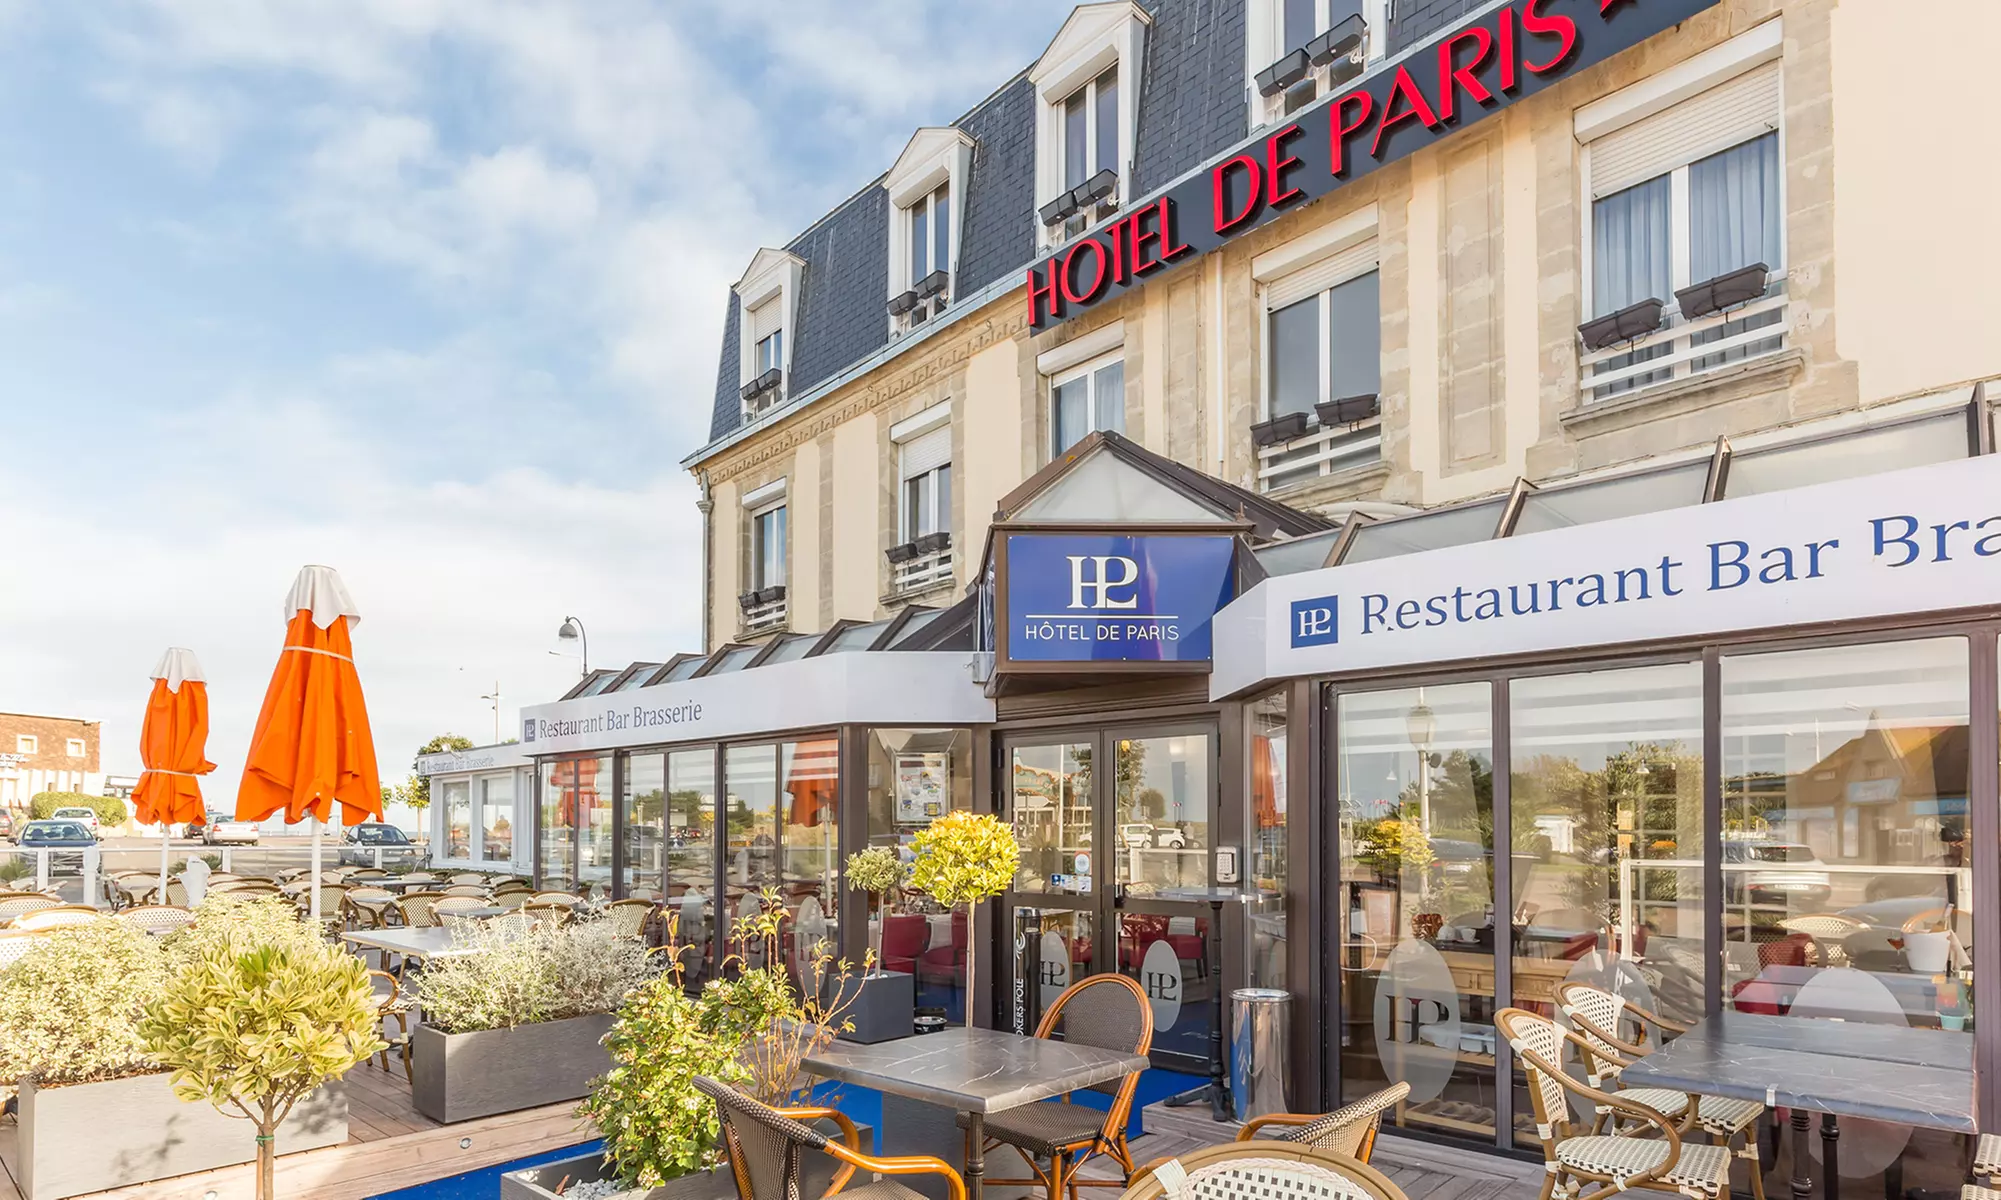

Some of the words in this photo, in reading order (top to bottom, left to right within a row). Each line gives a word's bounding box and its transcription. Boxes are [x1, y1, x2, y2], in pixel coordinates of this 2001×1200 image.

[1027, 196, 1190, 327] HOTEL
[1212, 124, 1302, 234] DE
[1329, 0, 1578, 176] PARIS
[1360, 554, 1684, 635] Restaurant
[1706, 538, 1840, 593] Bar
[1025, 620, 1090, 641] HÔTEL
[1096, 624, 1120, 641] DE
[1126, 624, 1180, 641] PARIS
[539, 714, 603, 739] Restaurant
[606, 709, 630, 731] Bar
[633, 699, 703, 728] Brasserie
